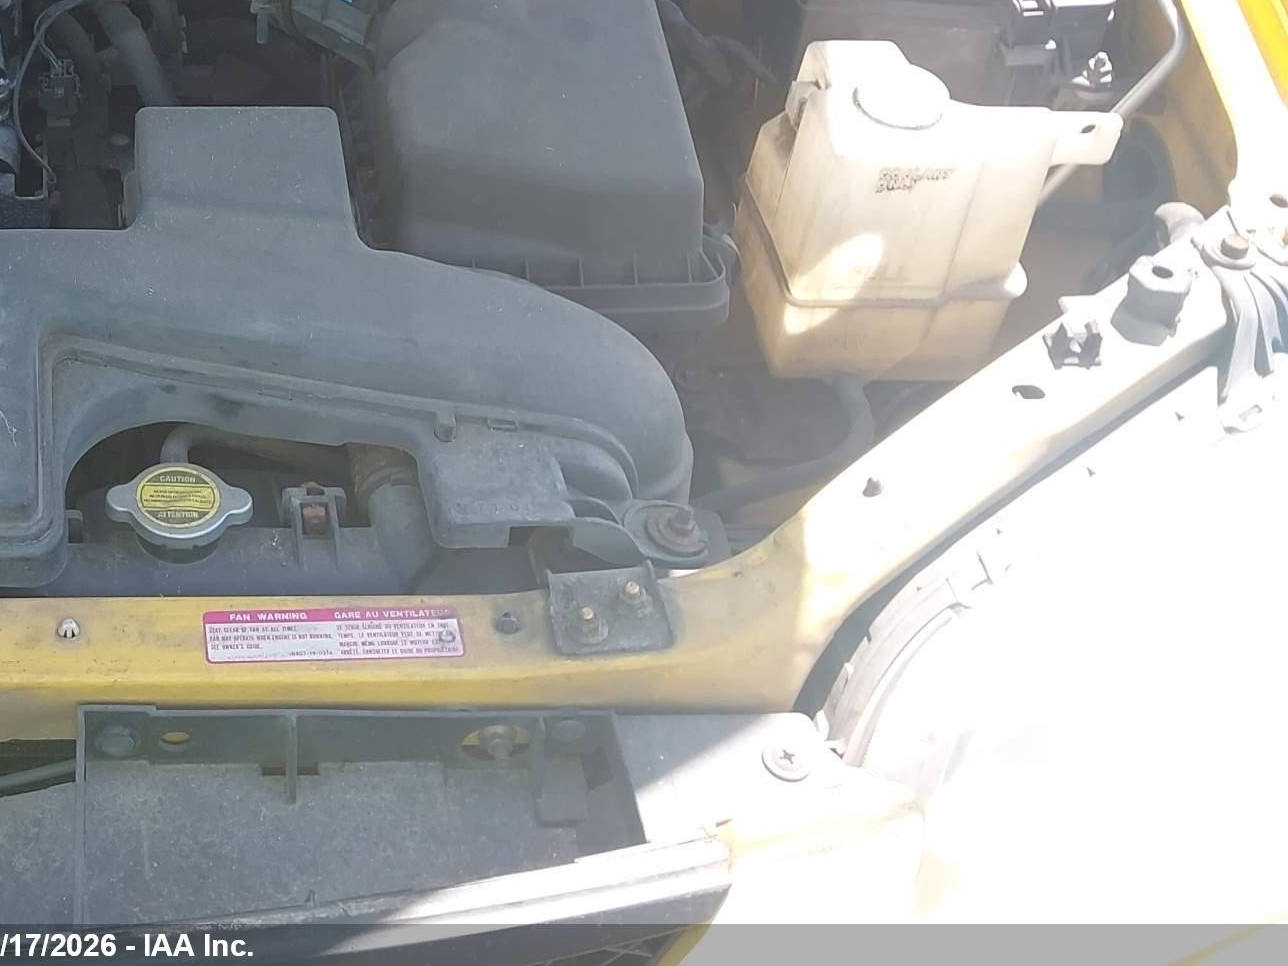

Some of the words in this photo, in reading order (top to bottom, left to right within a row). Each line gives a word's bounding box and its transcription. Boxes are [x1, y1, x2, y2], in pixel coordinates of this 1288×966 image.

[159, 475, 196, 483] CAUTION
[229, 613, 251, 622] FAN
[257, 612, 308, 621] WARNING
[334, 611, 361, 619] GARE
[365, 610, 379, 618] AU
